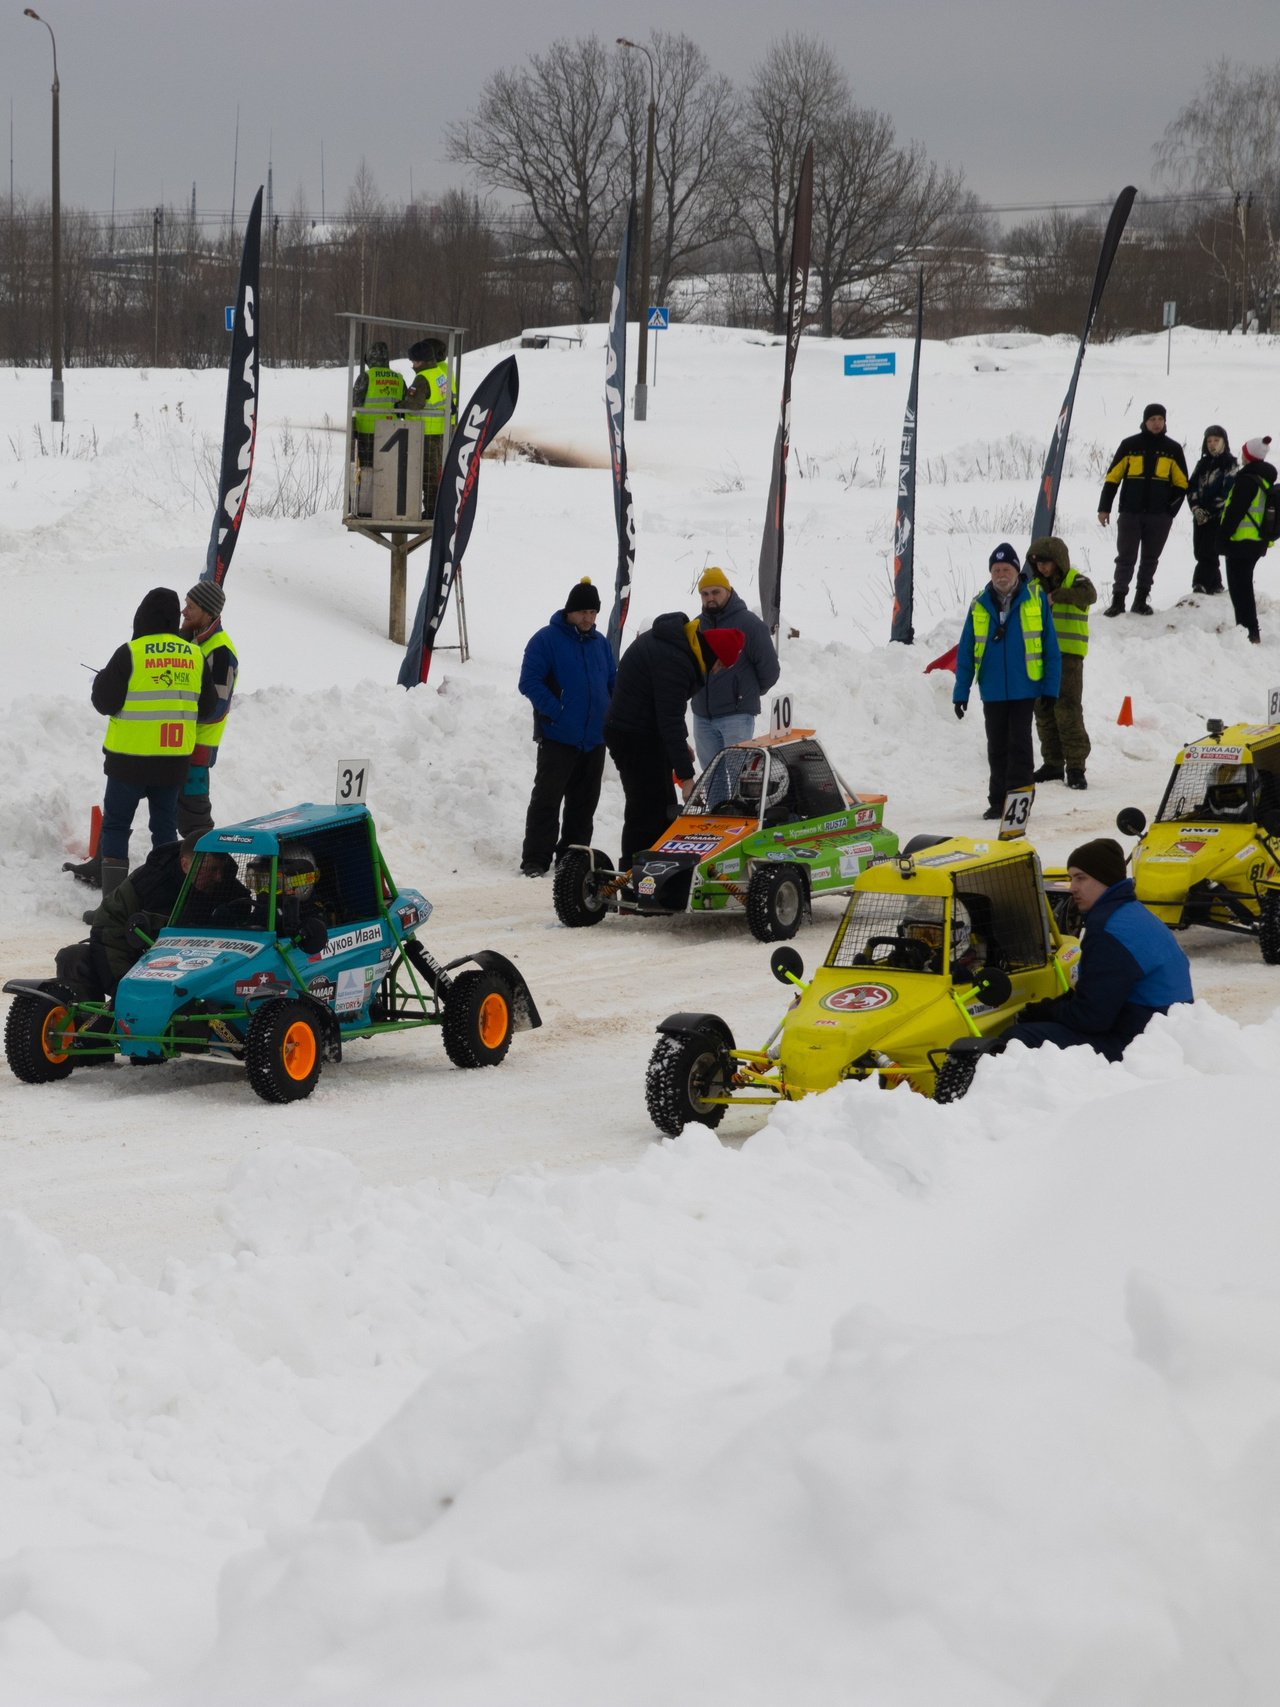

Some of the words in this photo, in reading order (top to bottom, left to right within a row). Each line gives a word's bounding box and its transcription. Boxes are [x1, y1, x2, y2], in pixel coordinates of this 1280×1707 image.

[379, 427, 409, 517] 1
[145, 641, 193, 655] RUSTA
[145, 658, 195, 670] МАРШАЛ
[174, 671, 190, 684] MSK
[773, 696, 791, 731] 10
[160, 722, 184, 748] 10
[340, 767, 366, 799] 31
[1004, 796, 1030, 826] 43
[824, 819, 847, 831] RUSTA
[662, 842, 717, 851] LIQUI
[1249, 862, 1266, 882] 81
[211, 940, 259, 954] РОССИИ
[322, 936, 353, 956] Жуков
[354, 926, 382, 944] Иван
[419, 947, 453, 990] YAMAH
